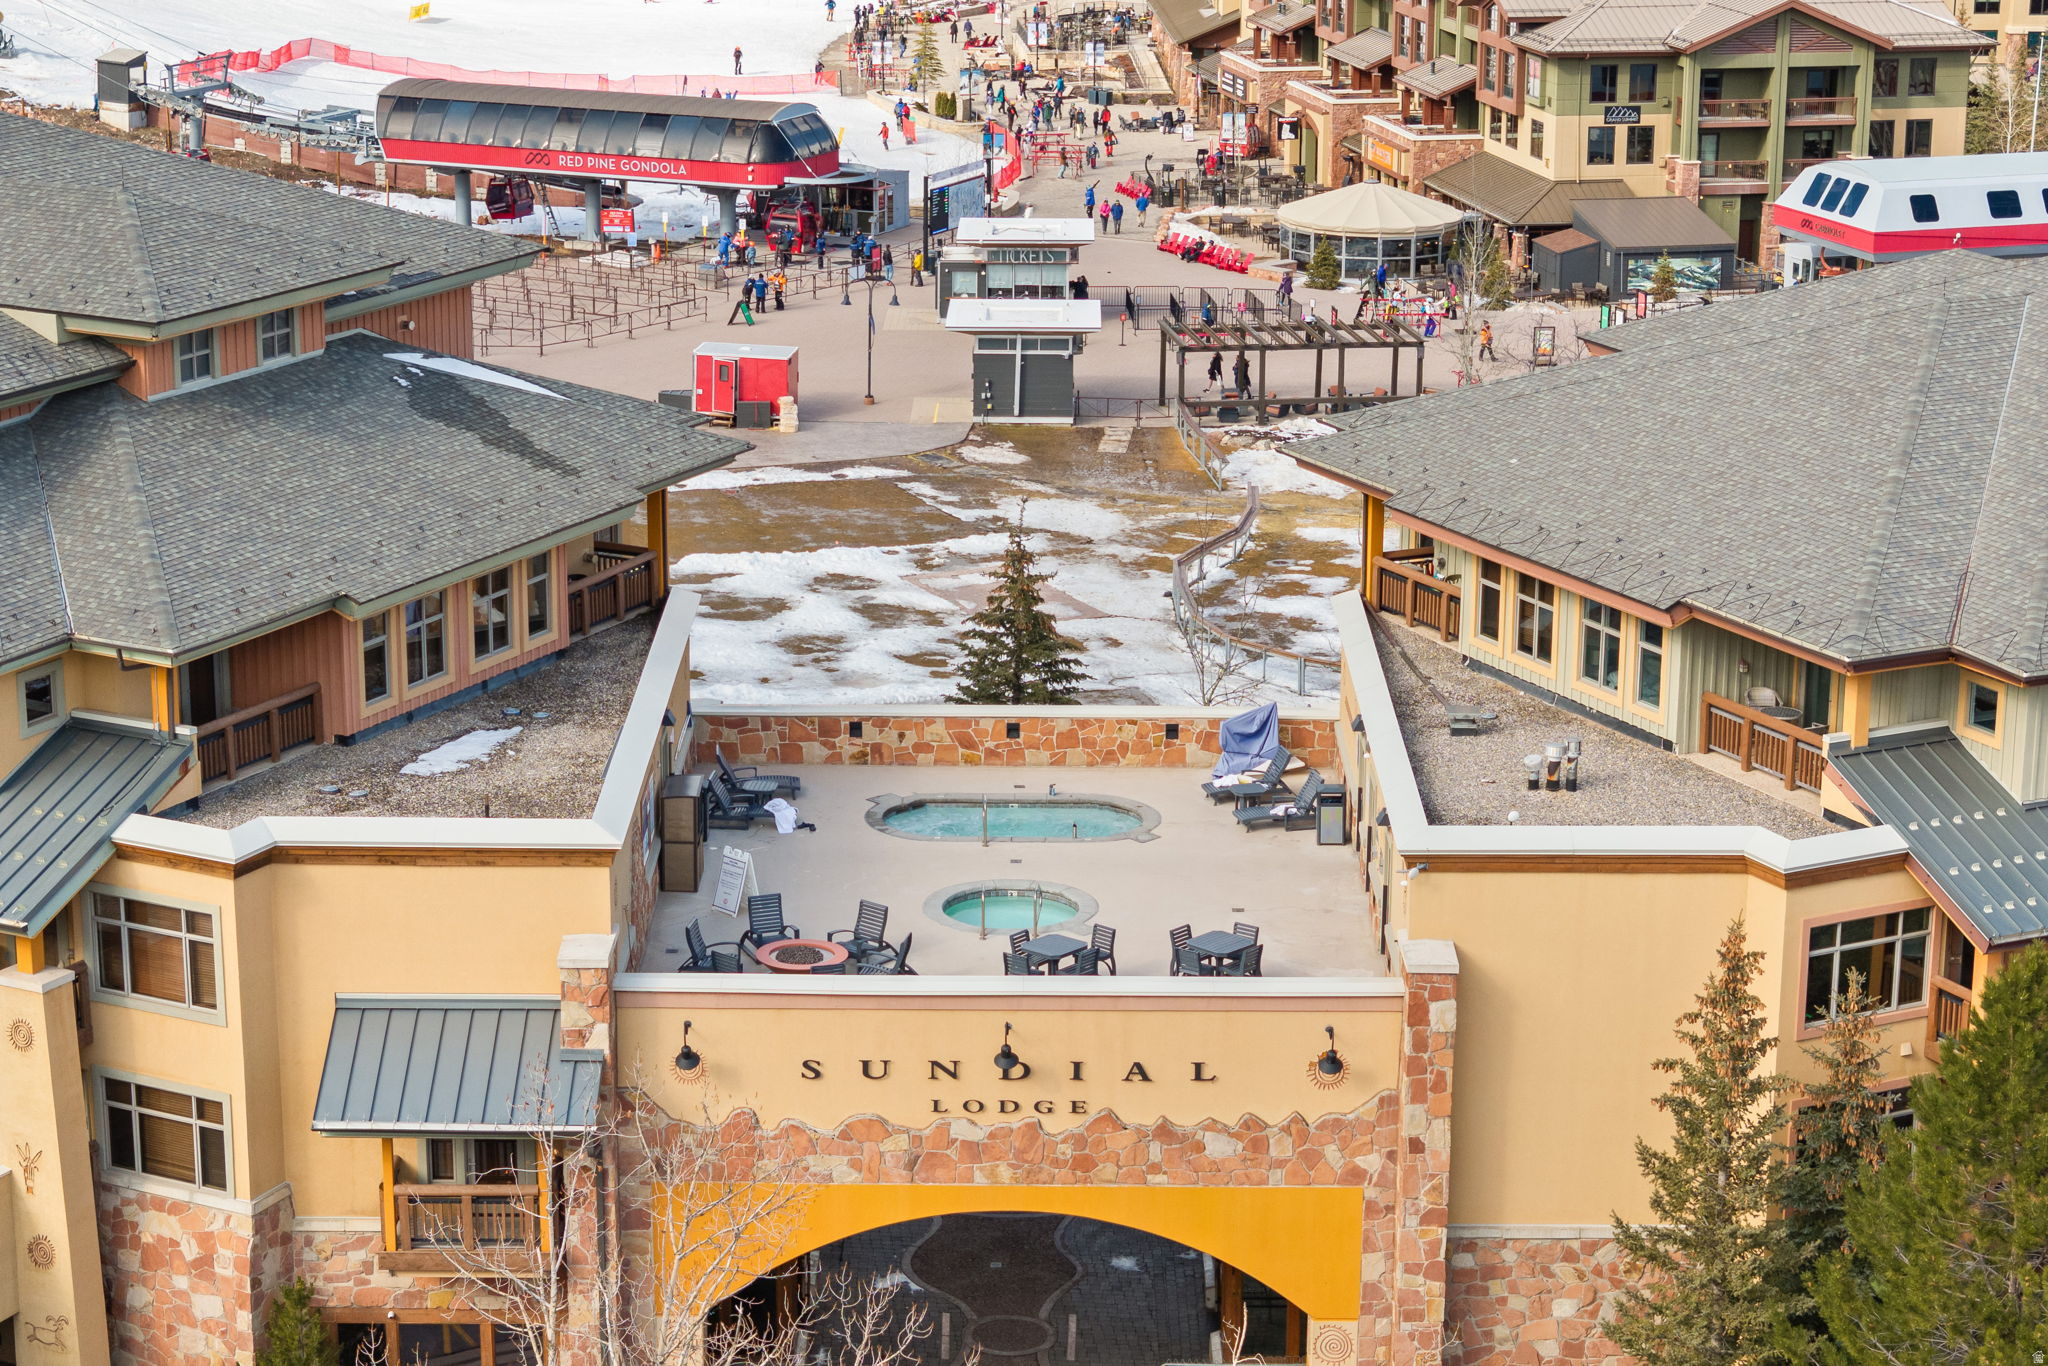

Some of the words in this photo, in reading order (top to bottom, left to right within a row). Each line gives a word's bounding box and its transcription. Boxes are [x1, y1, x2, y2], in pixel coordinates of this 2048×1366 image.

[559, 154, 583, 167] RED
[587, 157, 616, 170] PINE
[620, 160, 687, 175] GONDOLA
[996, 248, 1055, 263] TICKETS
[802, 1060, 1217, 1082] SUNDIAL
[931, 1100, 1087, 1114] LODGE
